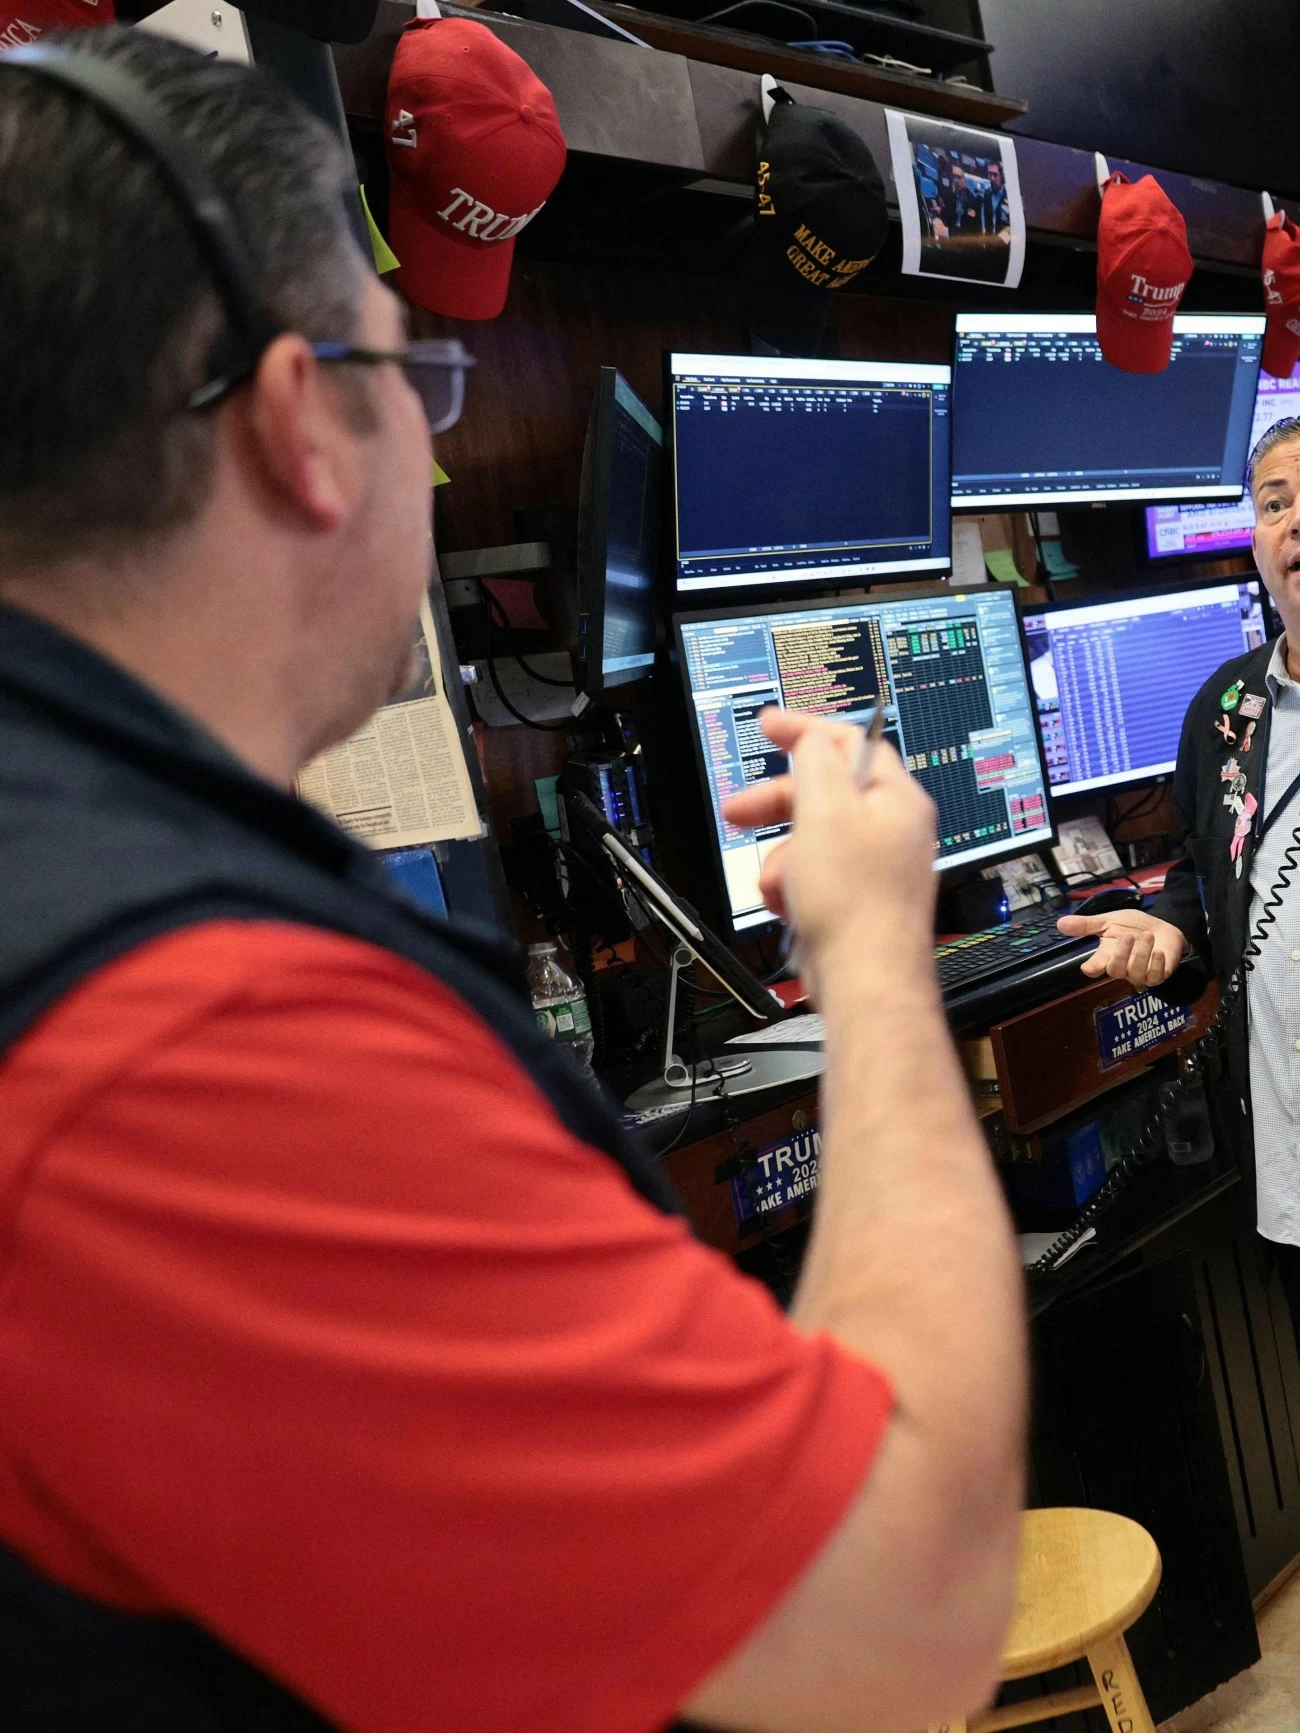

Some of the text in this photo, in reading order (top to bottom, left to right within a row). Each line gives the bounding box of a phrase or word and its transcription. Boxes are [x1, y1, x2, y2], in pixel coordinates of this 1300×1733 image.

[0, 18, 42, 50] ICA
[436, 187, 546, 241] TRUM
[794, 223, 836, 266] MAKE
[786, 245, 830, 286] GREAT
[1130, 273, 1185, 301] Trump
[1112, 1014, 1186, 1058] TAKE AMERICA BACK
[1136, 1014, 1159, 1035] 2024
[757, 1132, 823, 1178] TRU
[792, 1160, 819, 1183] 202
[786, 1175, 819, 1201] AMER
